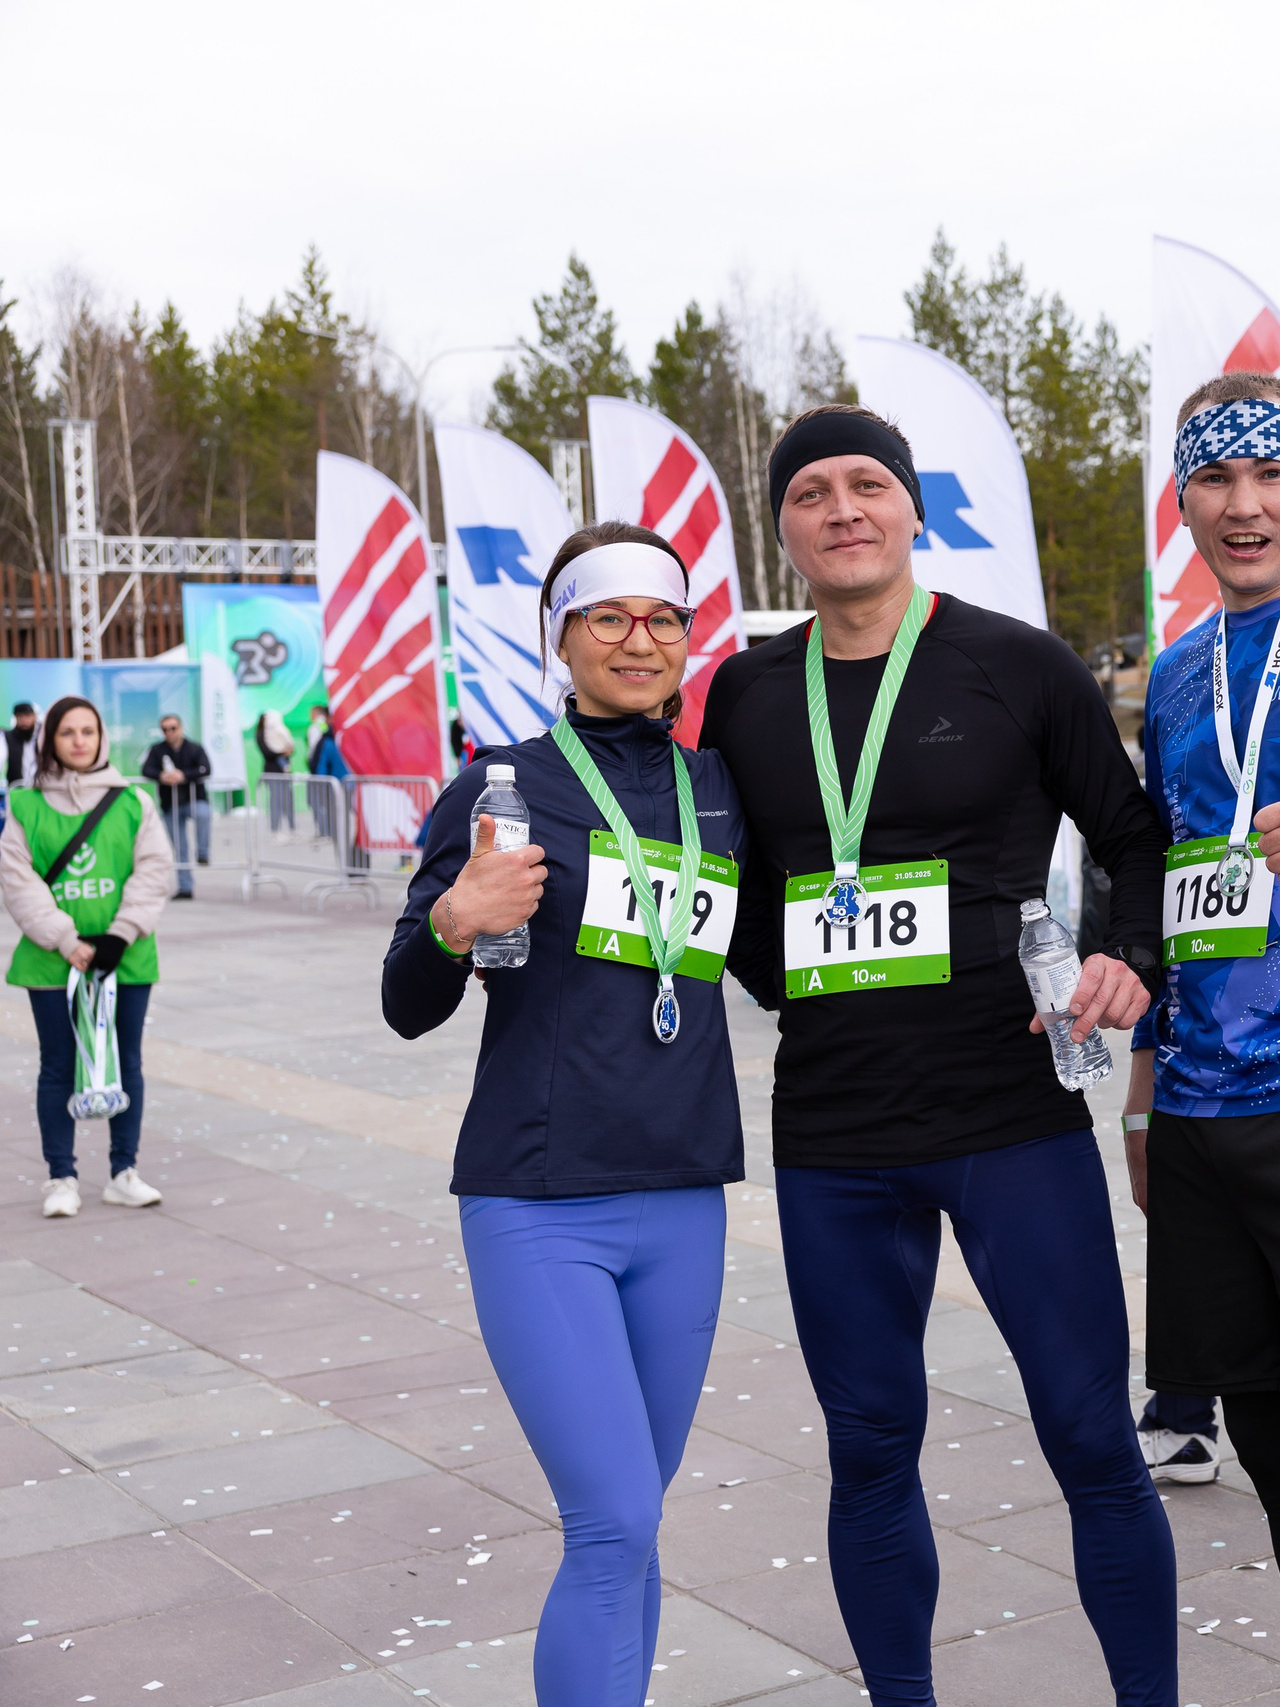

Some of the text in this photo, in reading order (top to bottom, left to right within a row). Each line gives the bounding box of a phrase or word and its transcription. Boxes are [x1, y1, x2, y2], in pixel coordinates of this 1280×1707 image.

[1214, 648, 1225, 713] НОЯБРЬСК
[918, 734, 965, 743] DEMIX
[1247, 740, 1257, 776] СБЕР
[701, 861, 728, 876] 31.05.2025
[894, 870, 931, 880] 31.05.2025
[51, 877, 115, 902] СБЕР
[806, 883, 820, 891] СБЕР
[621, 876, 713, 936] 119
[832, 907, 847, 916] 50
[815, 900, 917, 954] 1118
[603, 932, 620, 956] A
[808, 969, 823, 991] A
[661, 1022, 670, 1030] 50
